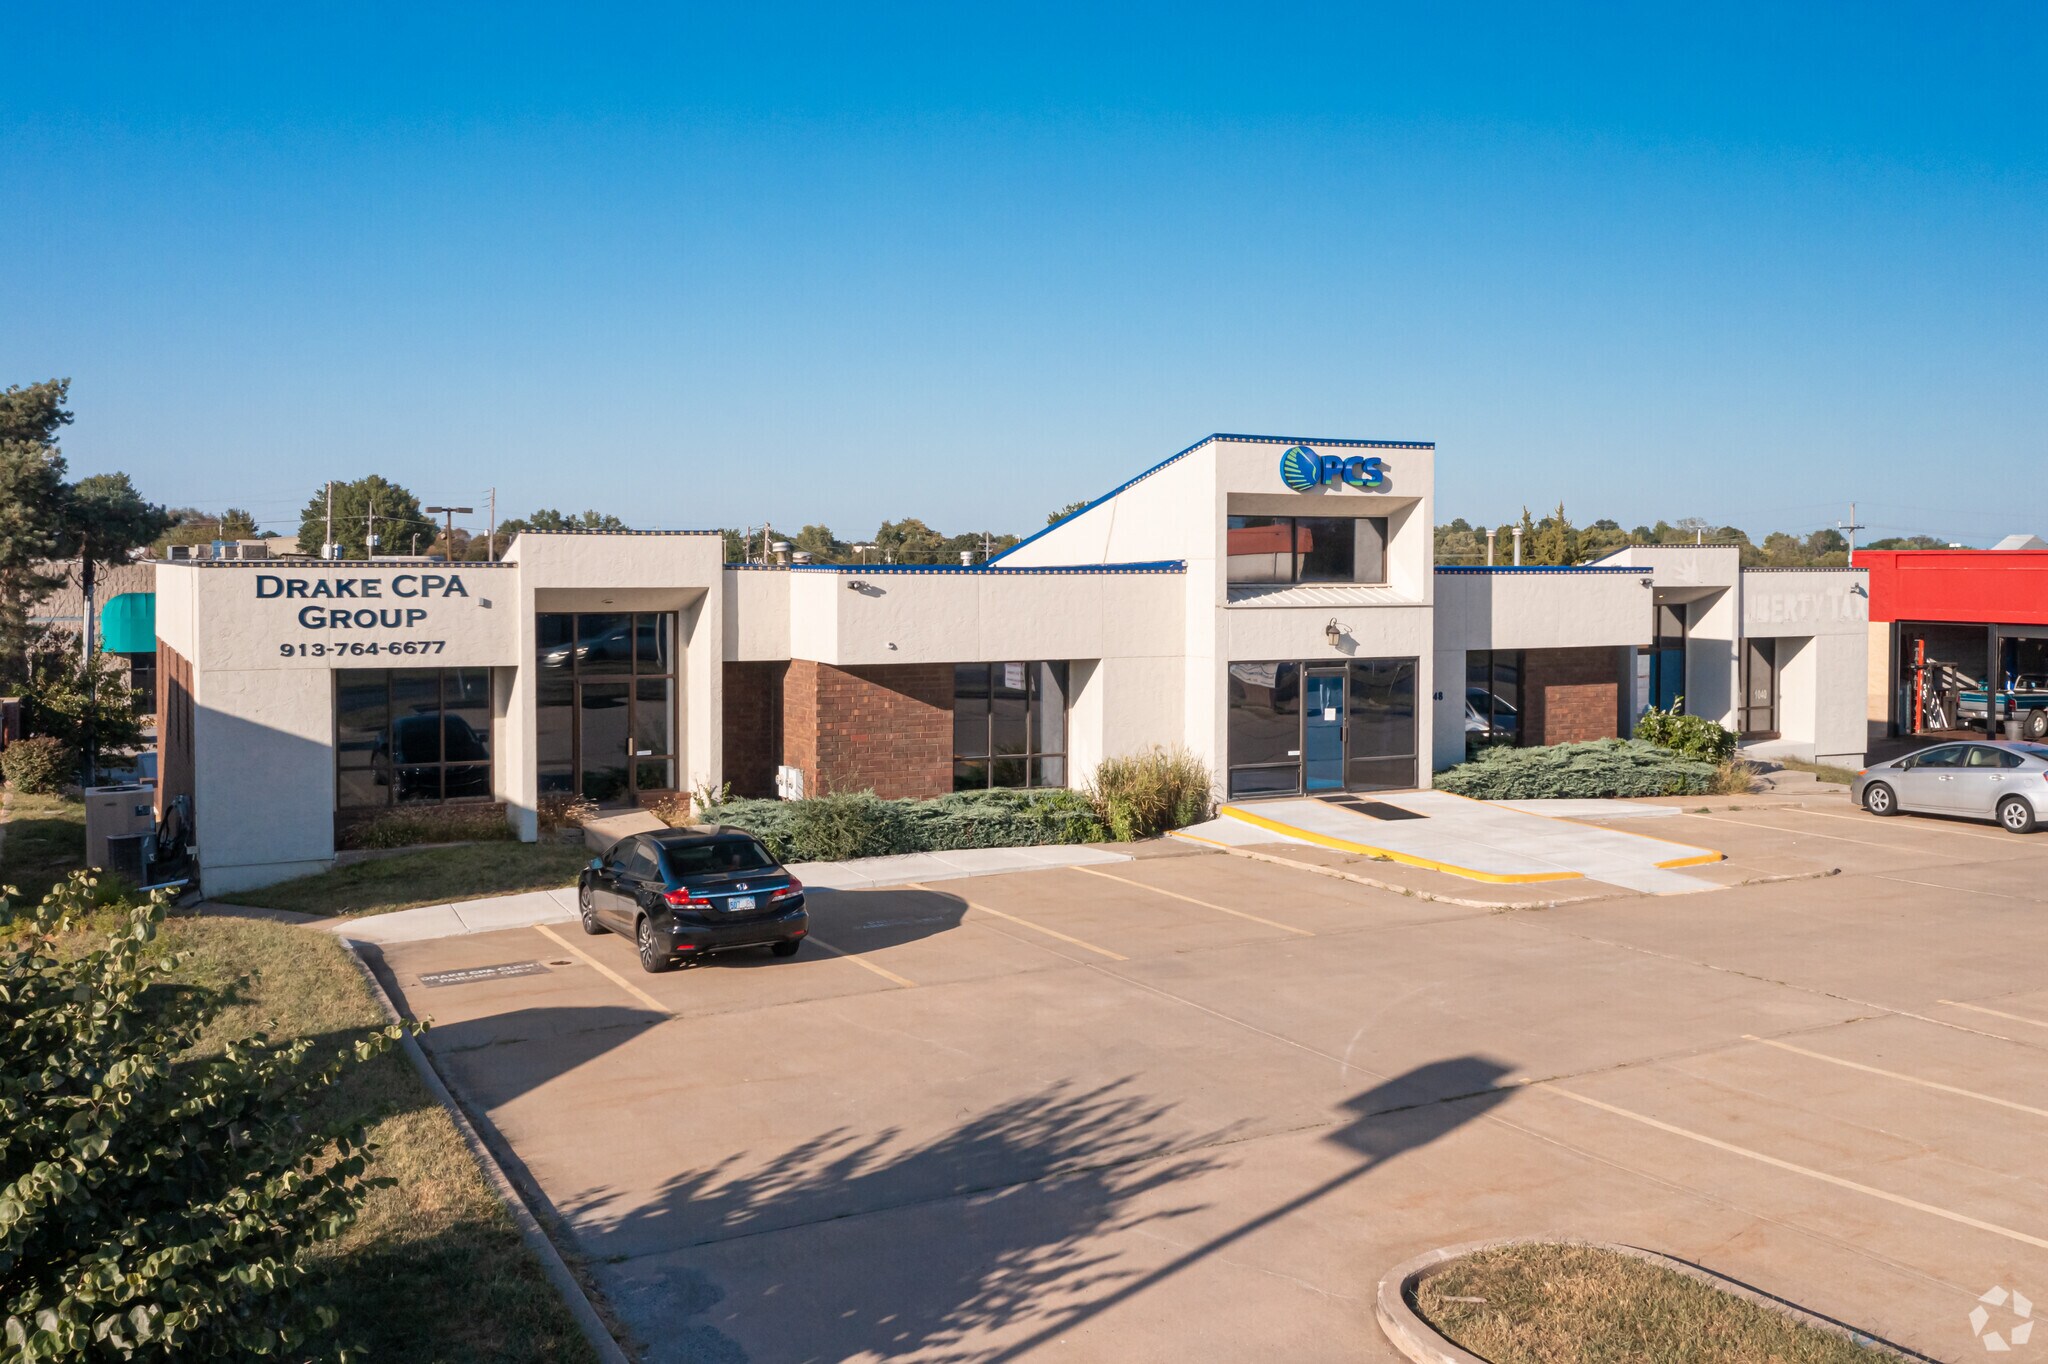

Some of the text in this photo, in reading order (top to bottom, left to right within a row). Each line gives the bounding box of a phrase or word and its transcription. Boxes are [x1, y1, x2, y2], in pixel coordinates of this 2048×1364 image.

[1320, 455, 1383, 487] PCS
[391, 574, 469, 598] CPA
[1744, 592, 1824, 623] IBERTY
[279, 640, 447, 658] 913-764-6677
[420, 972, 466, 981] DRAKE
[497, 963, 540, 971] CLIENT
